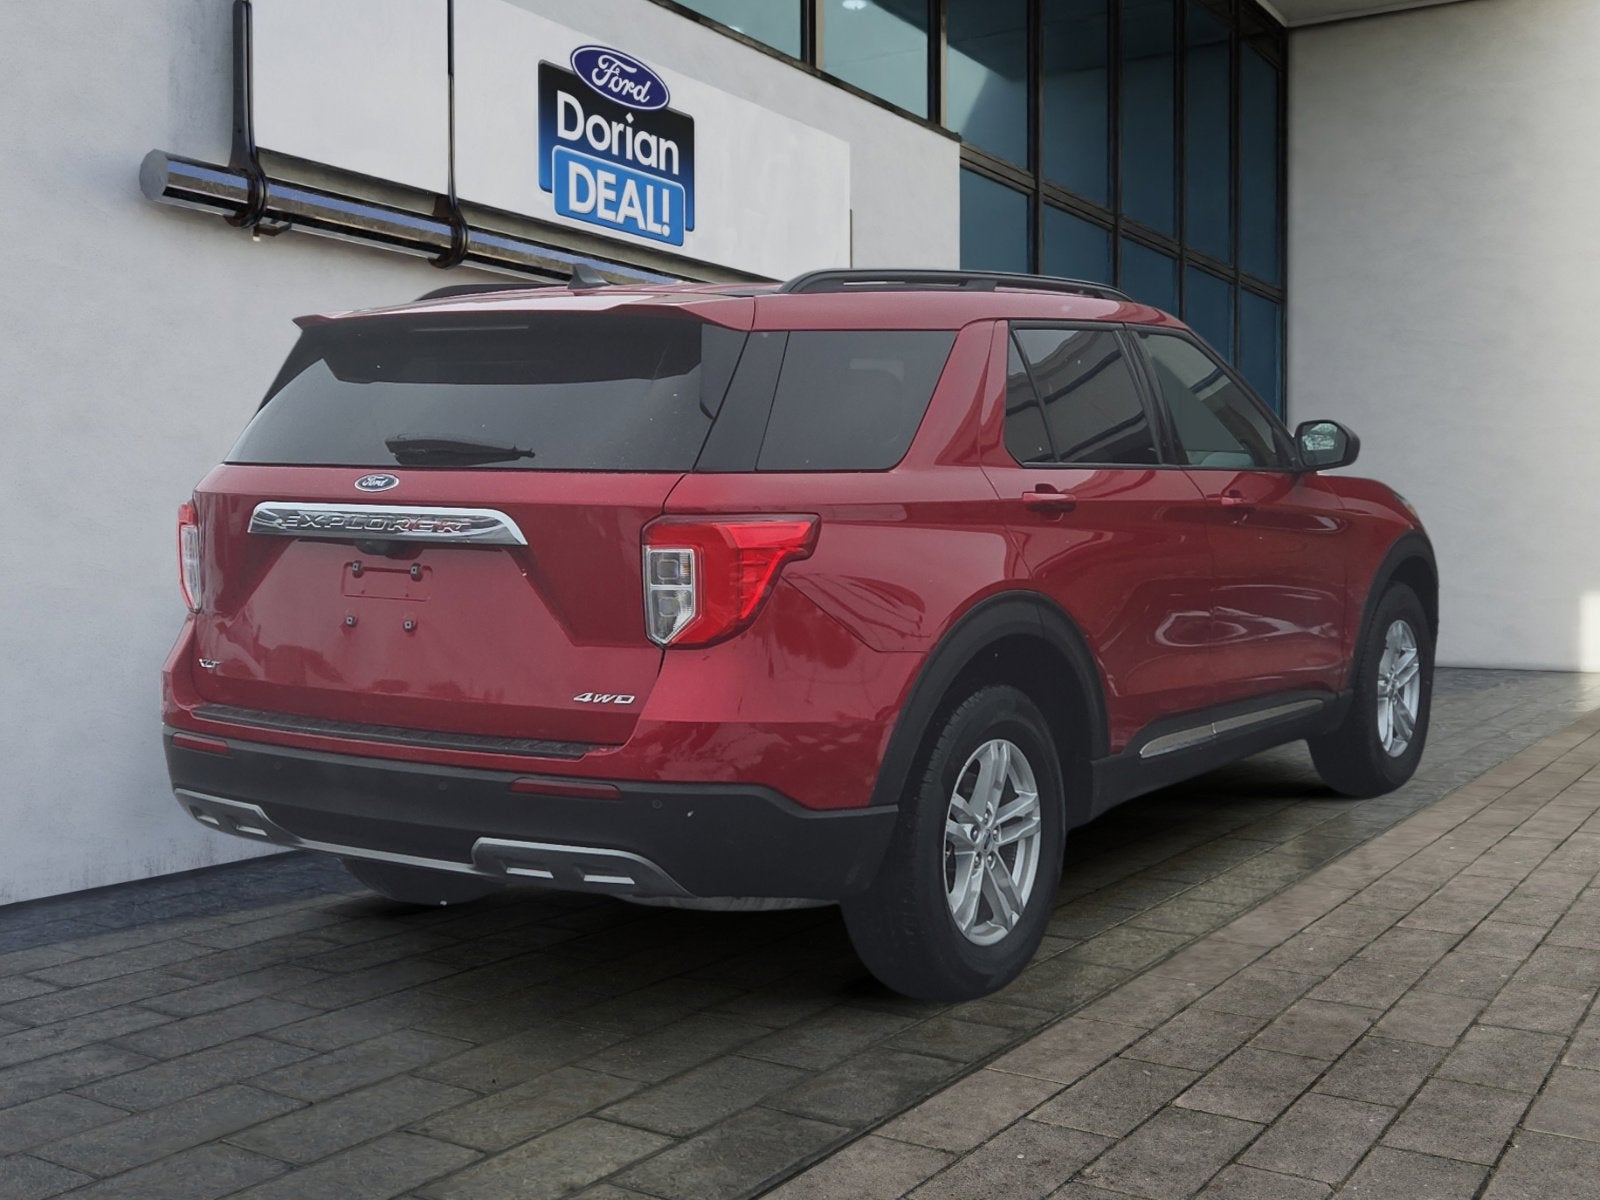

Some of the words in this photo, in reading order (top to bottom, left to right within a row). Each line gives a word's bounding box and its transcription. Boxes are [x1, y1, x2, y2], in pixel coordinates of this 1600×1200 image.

[592, 55, 651, 102] Ford
[557, 90, 679, 175] Dorian
[568, 161, 671, 237] DEAL!
[281, 514, 471, 533] EXPLORER
[573, 692, 635, 704] 4WD
